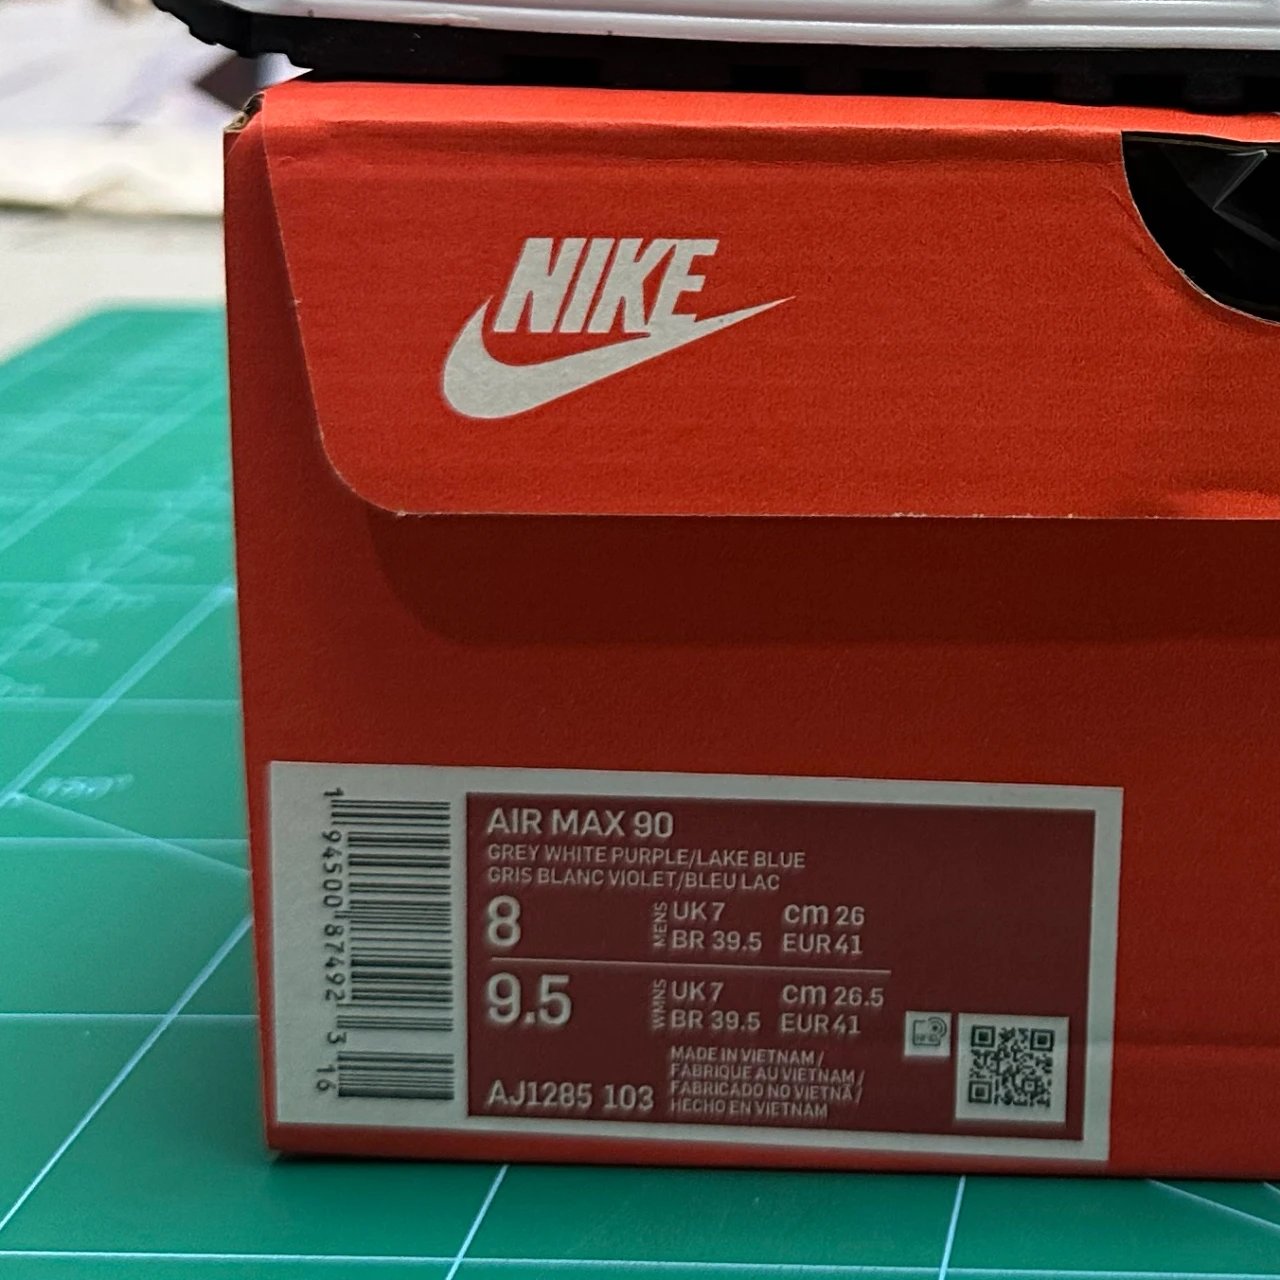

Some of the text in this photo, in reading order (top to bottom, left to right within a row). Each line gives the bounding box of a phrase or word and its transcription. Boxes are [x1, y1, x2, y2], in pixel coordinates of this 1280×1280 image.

[493, 236, 720, 334] NIKE
[487, 808, 674, 838] AIR MAX 90
[488, 844, 807, 869] GREY WHITE PURPLE/LAKE BLUE
[488, 866, 781, 891] GRIS BLANC VIOLET/BLEU LAC
[486, 895, 522, 948] 8
[673, 901, 726, 921] UK 7
[784, 903, 866, 926] cm 26
[653, 901, 669, 948] MENS
[671, 930, 763, 951] BR 39.5
[782, 933, 864, 955] EUR 41
[486, 971, 573, 1028] 9.5
[670, 981, 725, 1002] UK 7
[782, 984, 885, 1008] cm 26.5
[670, 1009, 761, 1032] BR 39.5
[780, 1013, 861, 1035] EUR 41
[670, 1046, 718, 1061] MADE
[721, 1048, 738, 1062] IN
[741, 1049, 815, 1065] VIETNAM
[670, 1063, 752, 1079] FABRIQUE
[755, 1067, 779, 1080] AU
[782, 1068, 855, 1083] VIETNAM
[488, 1080, 655, 1111] AJ1285 103
[670, 1080, 764, 1098] FABRICADO
[768, 1084, 791, 1099] NO
[670, 1098, 828, 1117] HECHO EN VIETNAM
